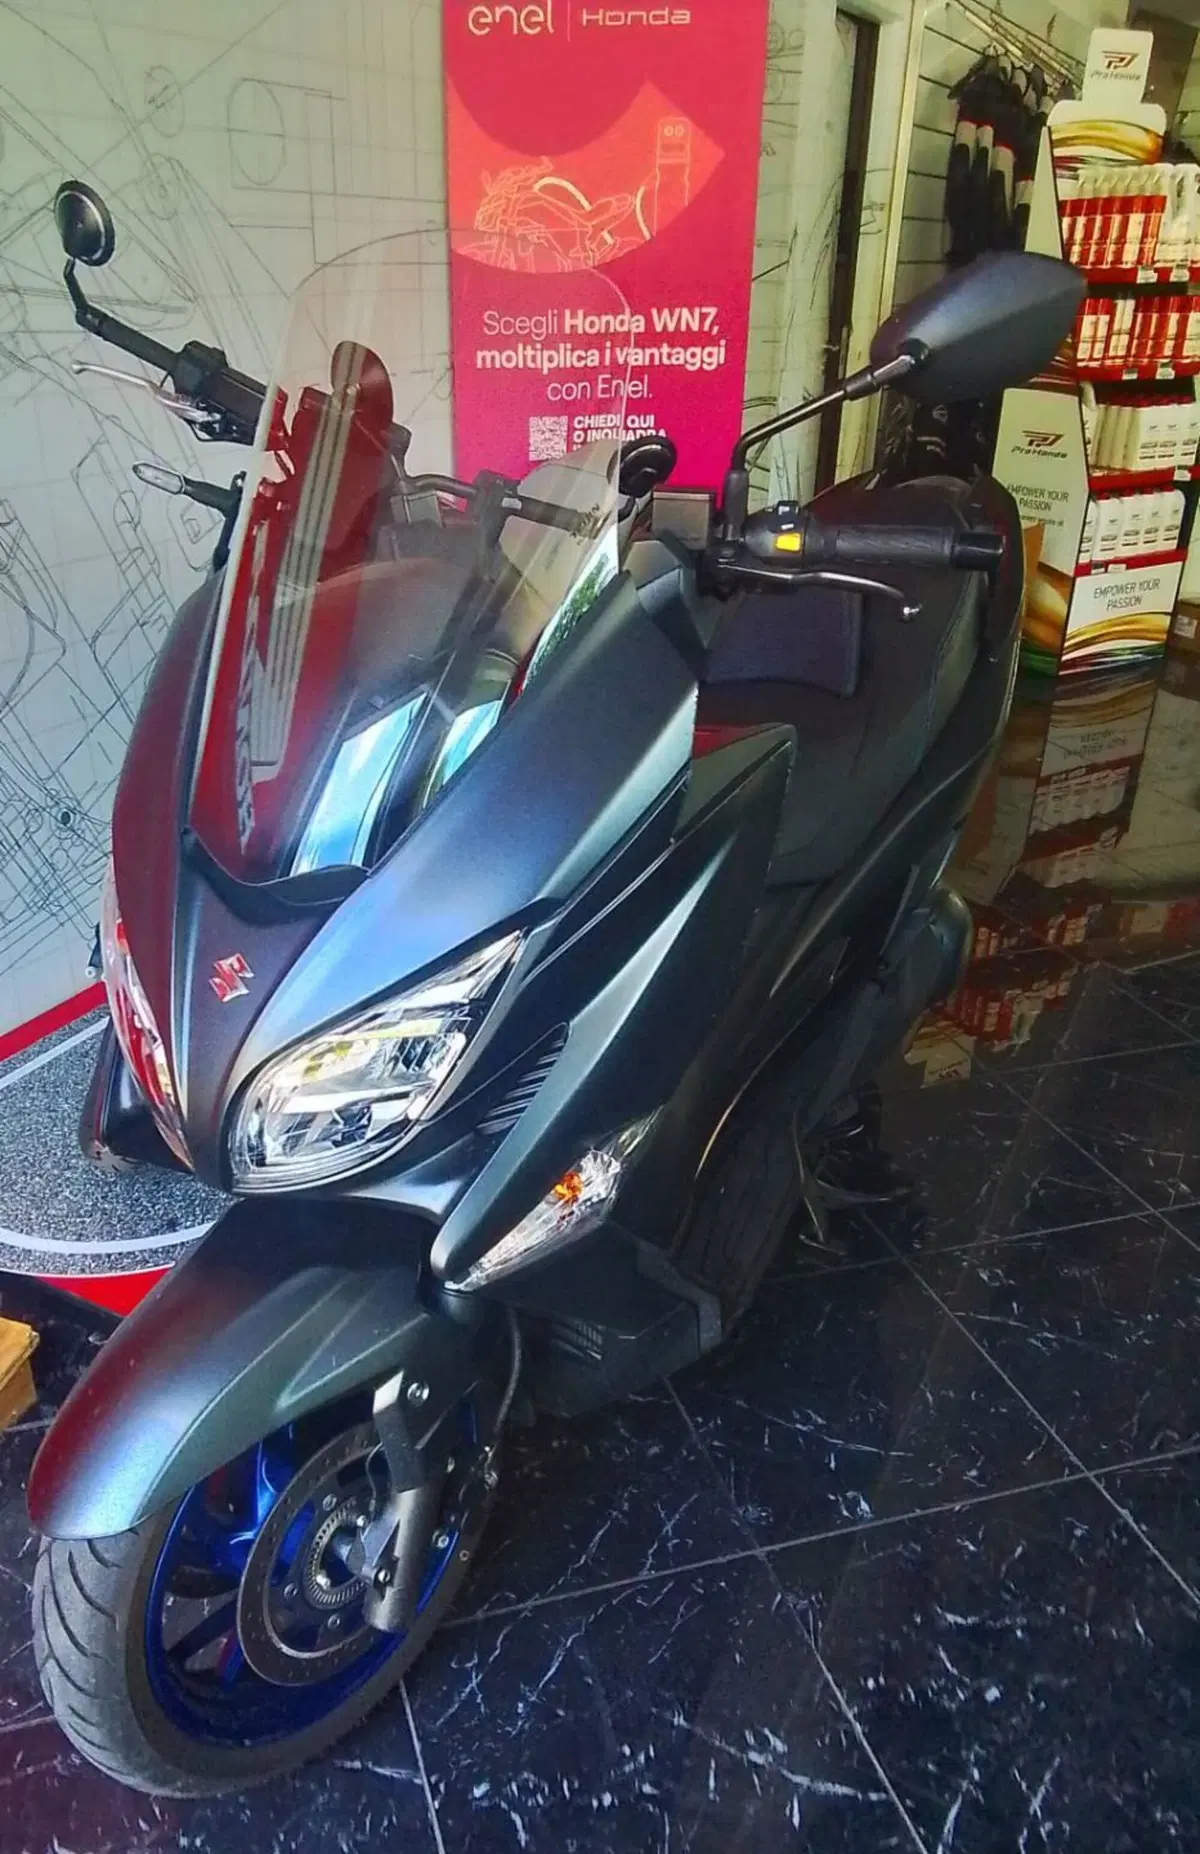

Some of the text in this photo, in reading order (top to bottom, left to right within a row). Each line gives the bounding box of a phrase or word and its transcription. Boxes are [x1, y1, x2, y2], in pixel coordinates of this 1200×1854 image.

[468, 0, 690, 35] enel Honda
[483, 306, 719, 341] Scegli Honda WN7,
[476, 339, 726, 374] moltiplica i vantaggi
[547, 374, 653, 400] con Enel.
[573, 413, 655, 429] CHIEDI QUI
[573, 430, 585, 443] O
[1093, 577, 1161, 599] EMPOWER YOUR
[1106, 595, 1143, 611] PASSION
